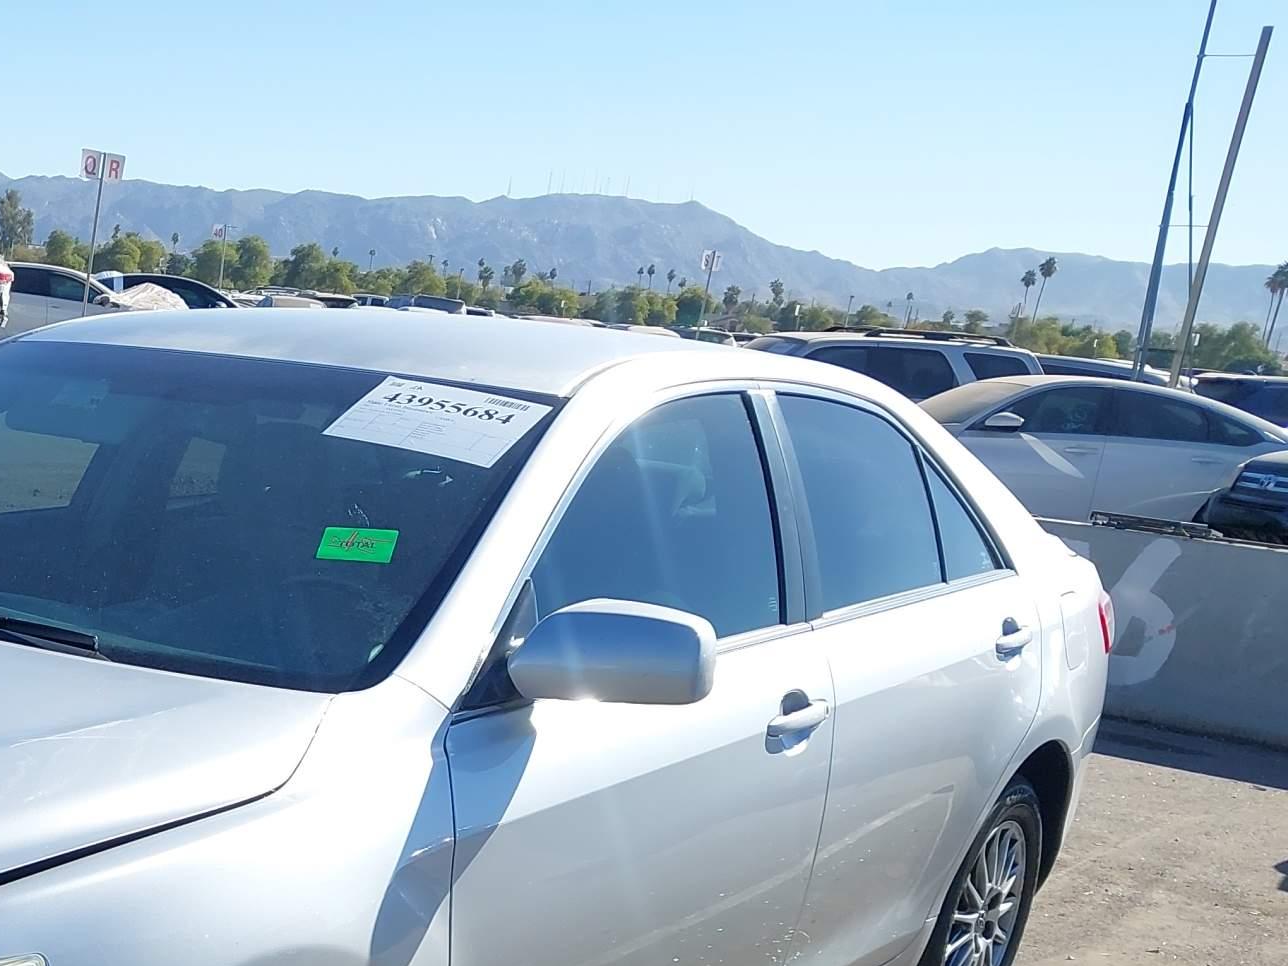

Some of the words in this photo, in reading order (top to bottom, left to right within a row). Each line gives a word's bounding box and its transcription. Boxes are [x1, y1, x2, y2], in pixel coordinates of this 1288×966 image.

[85, 155, 97, 176] Q
[108, 159, 120, 179] R
[383, 392, 516, 425] 43955684
